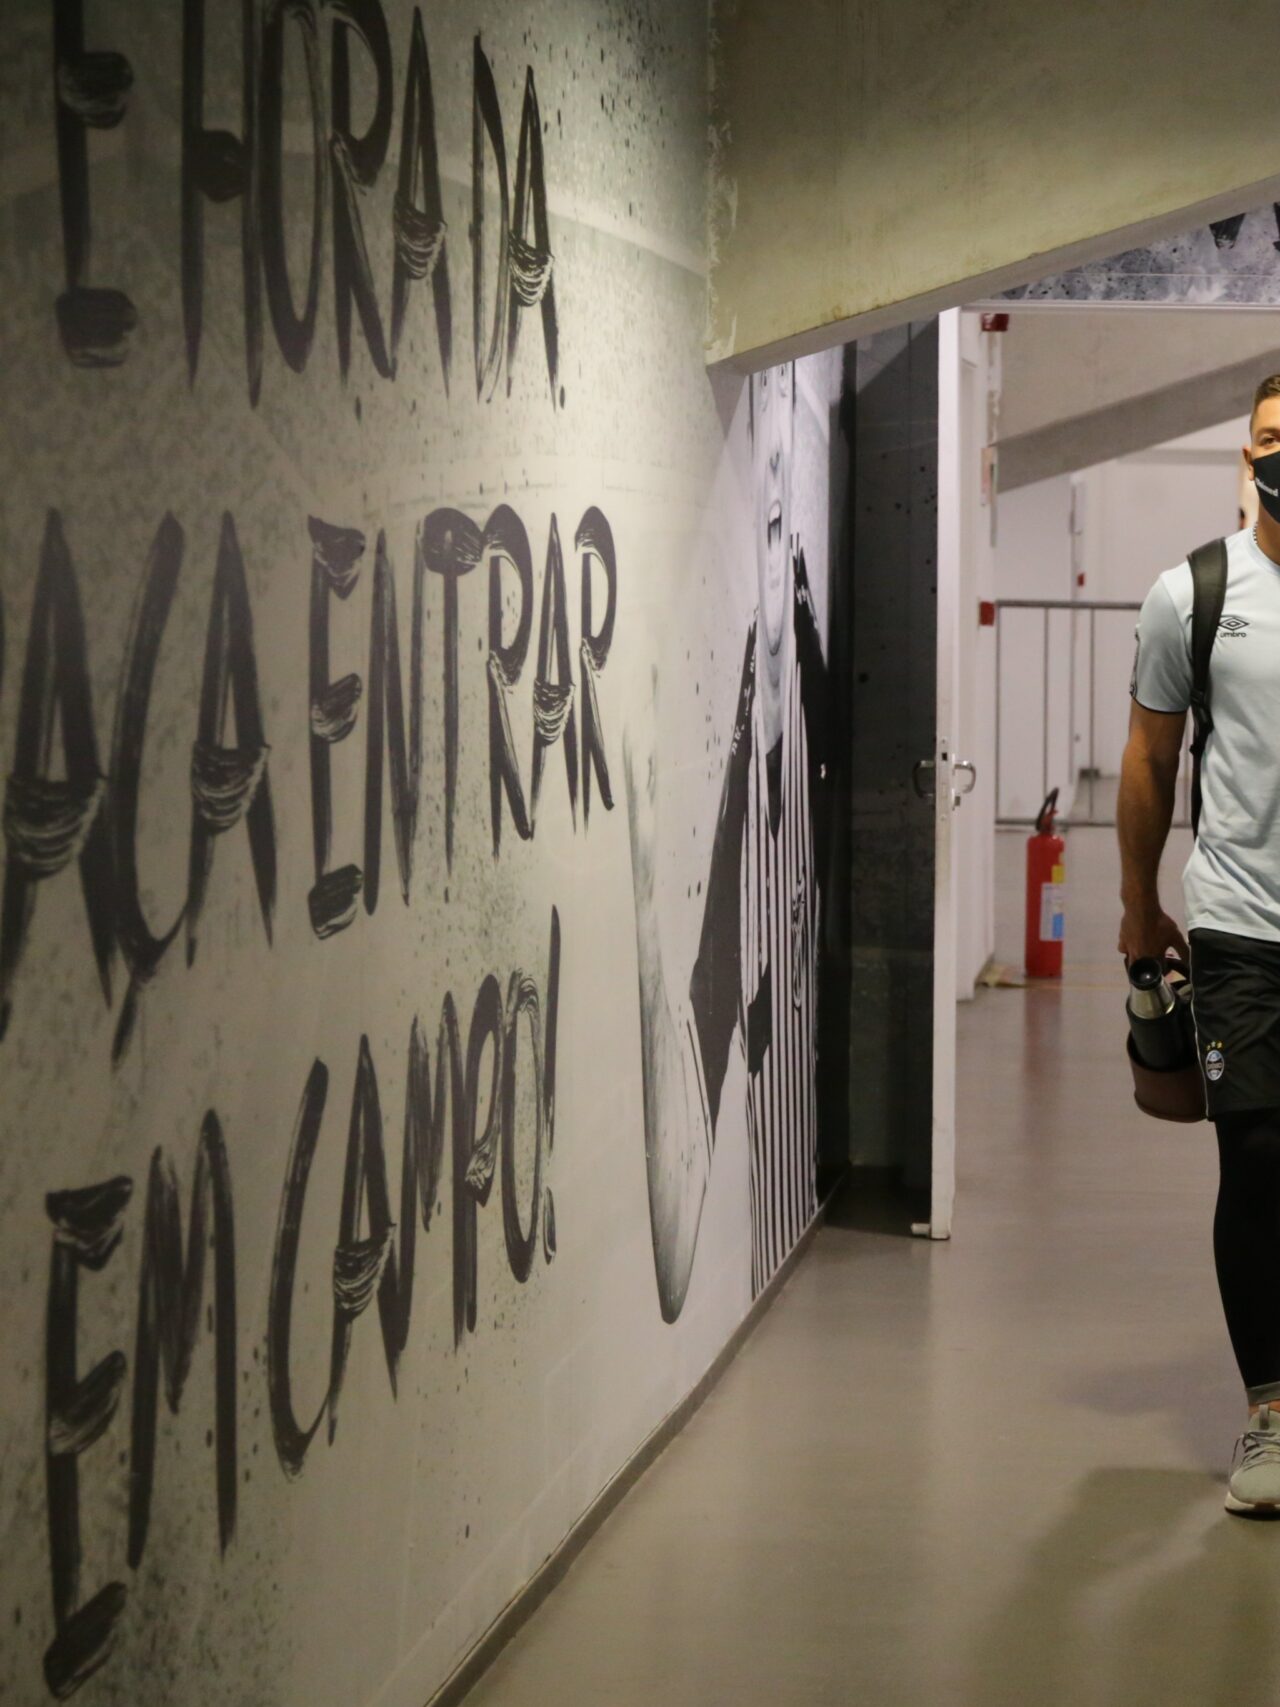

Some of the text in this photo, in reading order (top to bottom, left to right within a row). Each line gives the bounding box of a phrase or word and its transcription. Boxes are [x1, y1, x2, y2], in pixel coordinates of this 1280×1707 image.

[181, 0, 452, 410] HORA
[469, 33, 559, 412] DA
[307, 503, 617, 940] ENTRAR
[44, 904, 561, 1700] EM CAMPO!
